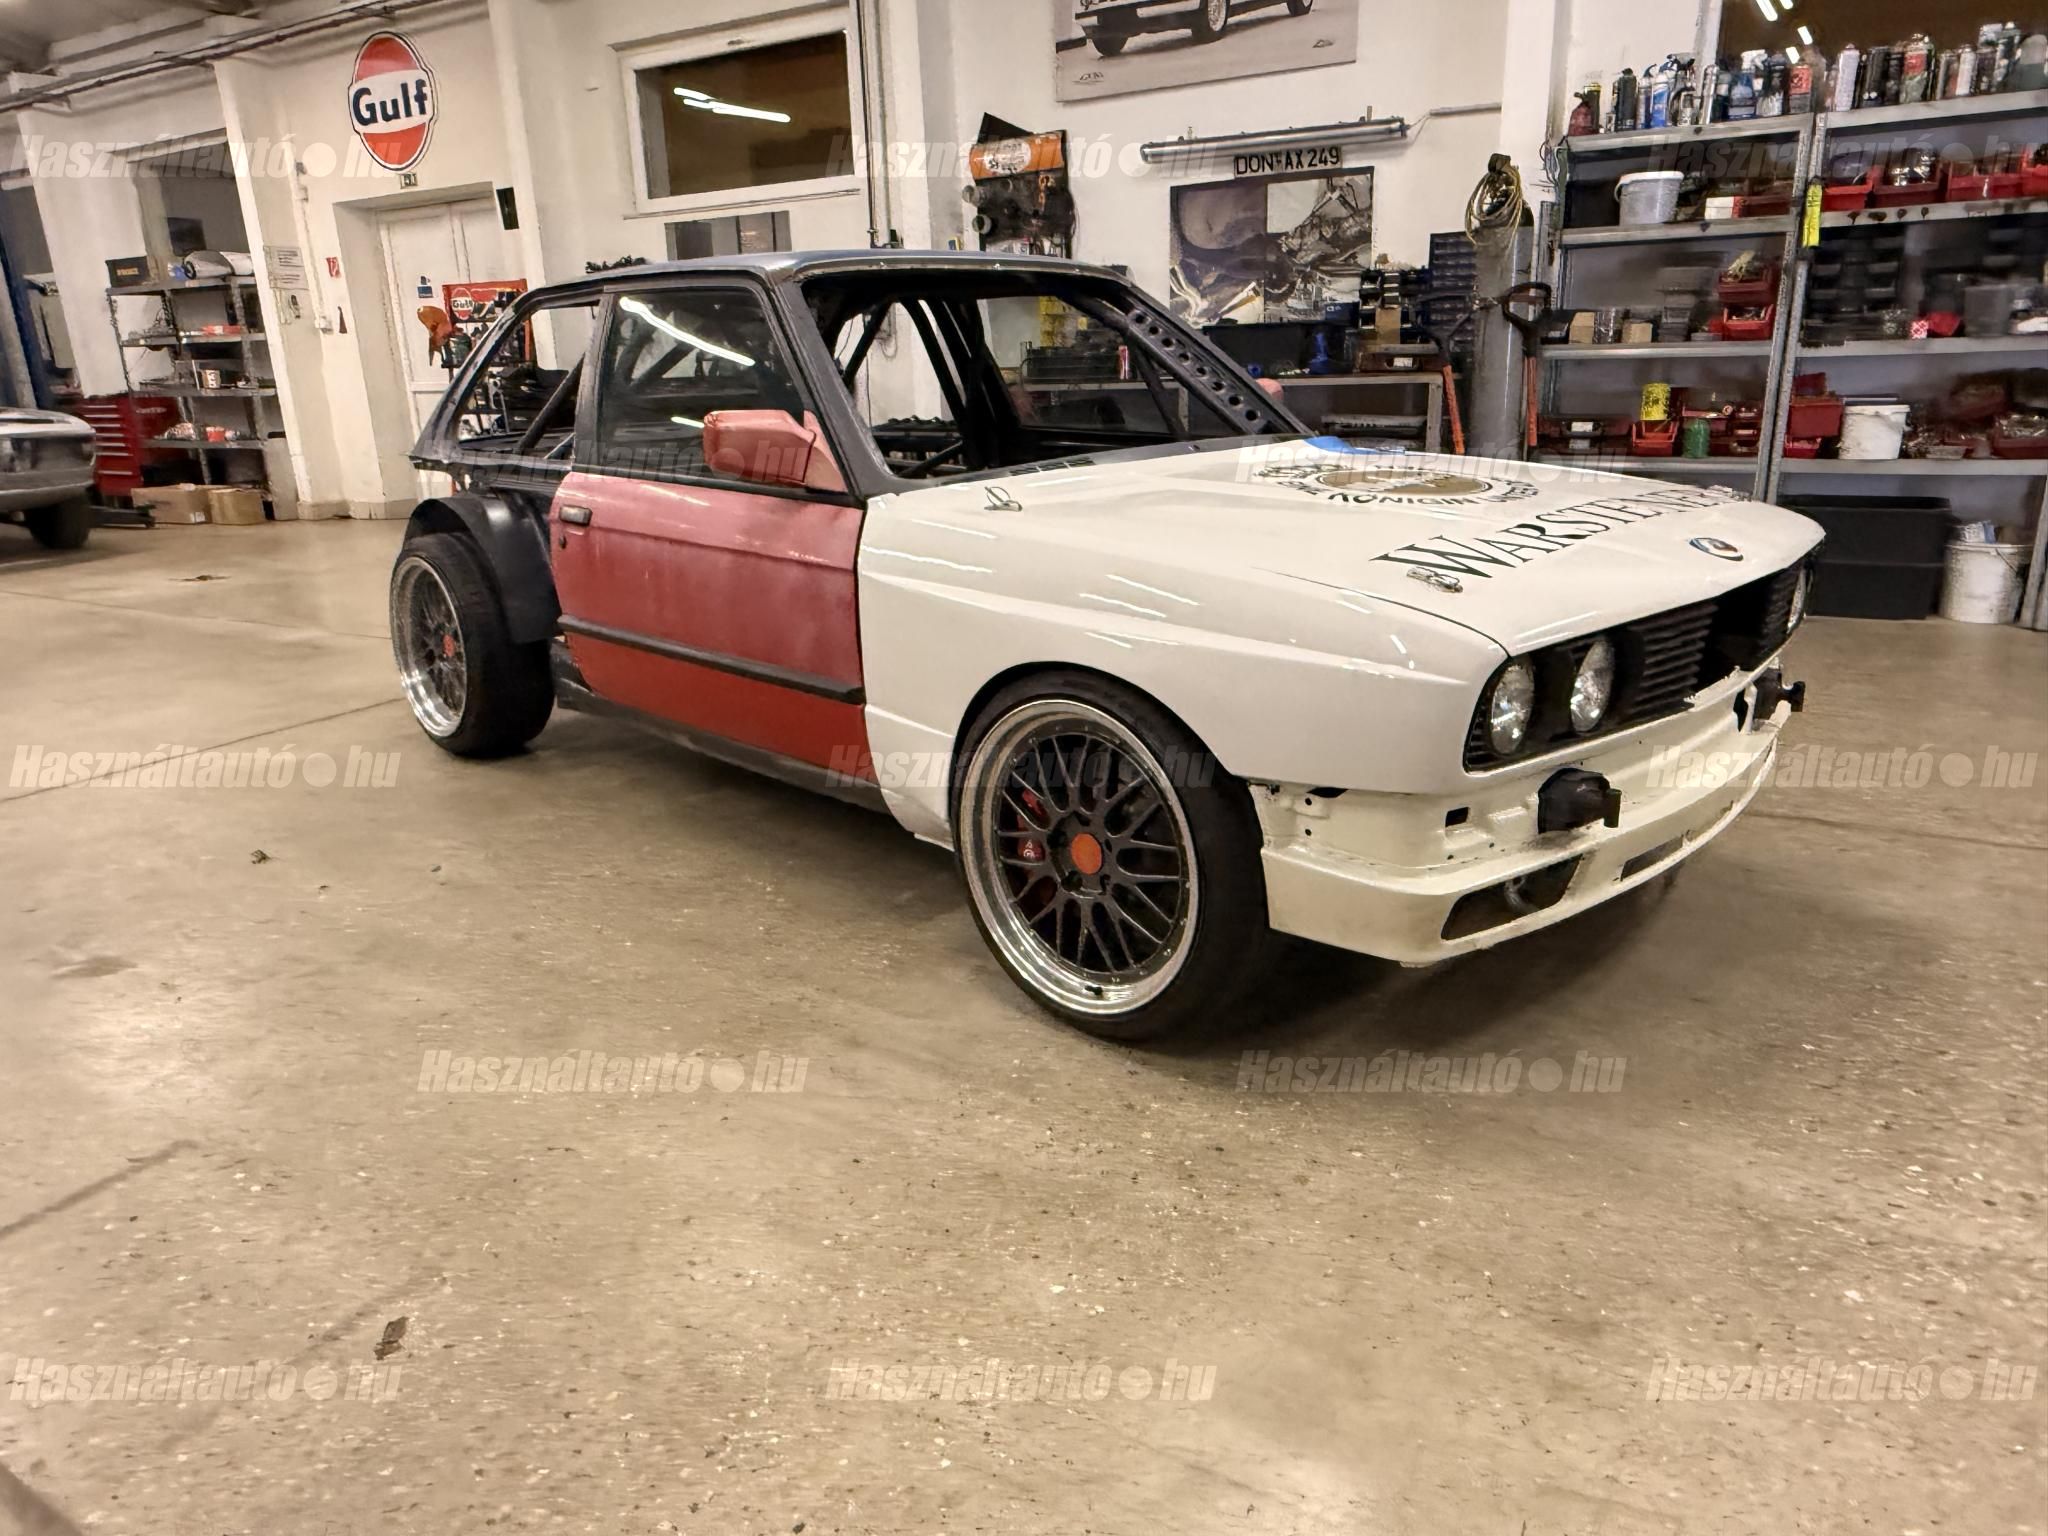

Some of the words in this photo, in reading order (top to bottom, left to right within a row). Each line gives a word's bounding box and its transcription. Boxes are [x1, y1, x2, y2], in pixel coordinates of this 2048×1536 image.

[353, 79, 428, 126] Gulf
[1236, 152, 1275, 175] DON
[1307, 146, 1340, 168] 249
[1369, 488, 1738, 578] WARSTENER
